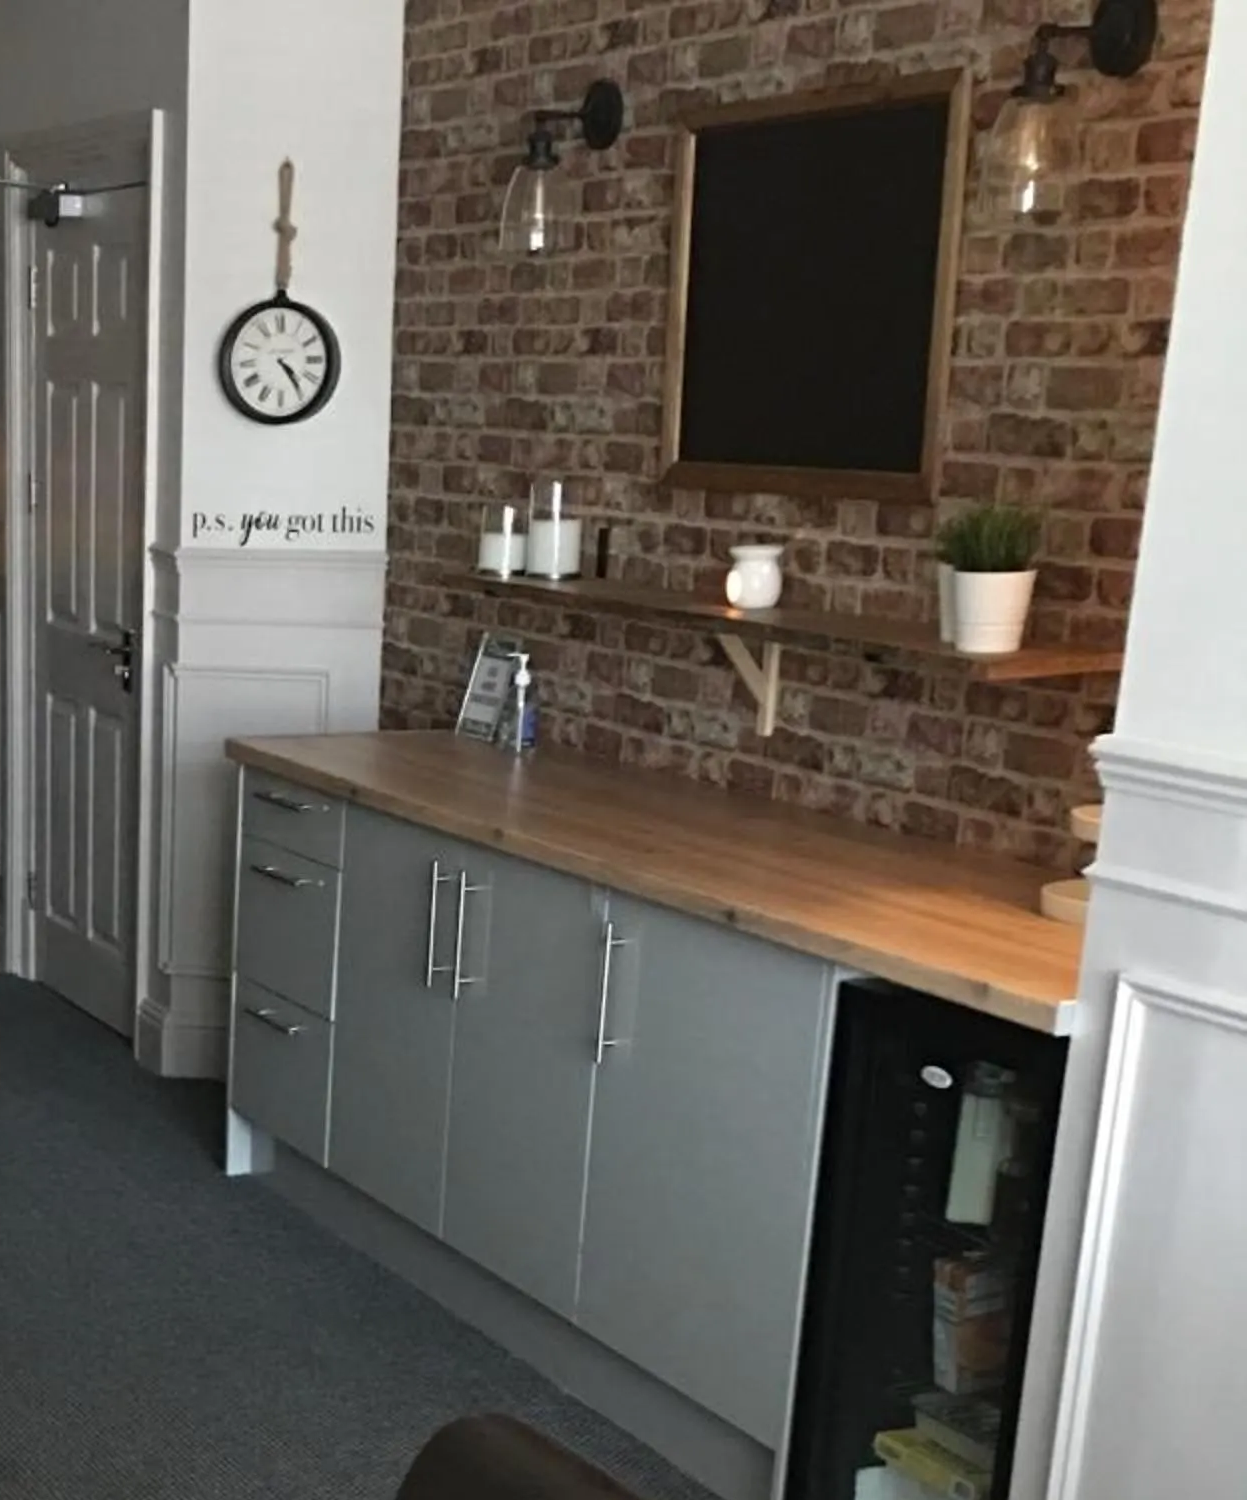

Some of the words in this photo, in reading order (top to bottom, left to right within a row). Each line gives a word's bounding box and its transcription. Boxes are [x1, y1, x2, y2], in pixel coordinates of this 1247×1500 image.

[193, 512, 234, 538] p.s.
[240, 511, 280, 547] you
[285, 513, 325, 541] got
[332, 506, 375, 533] this
